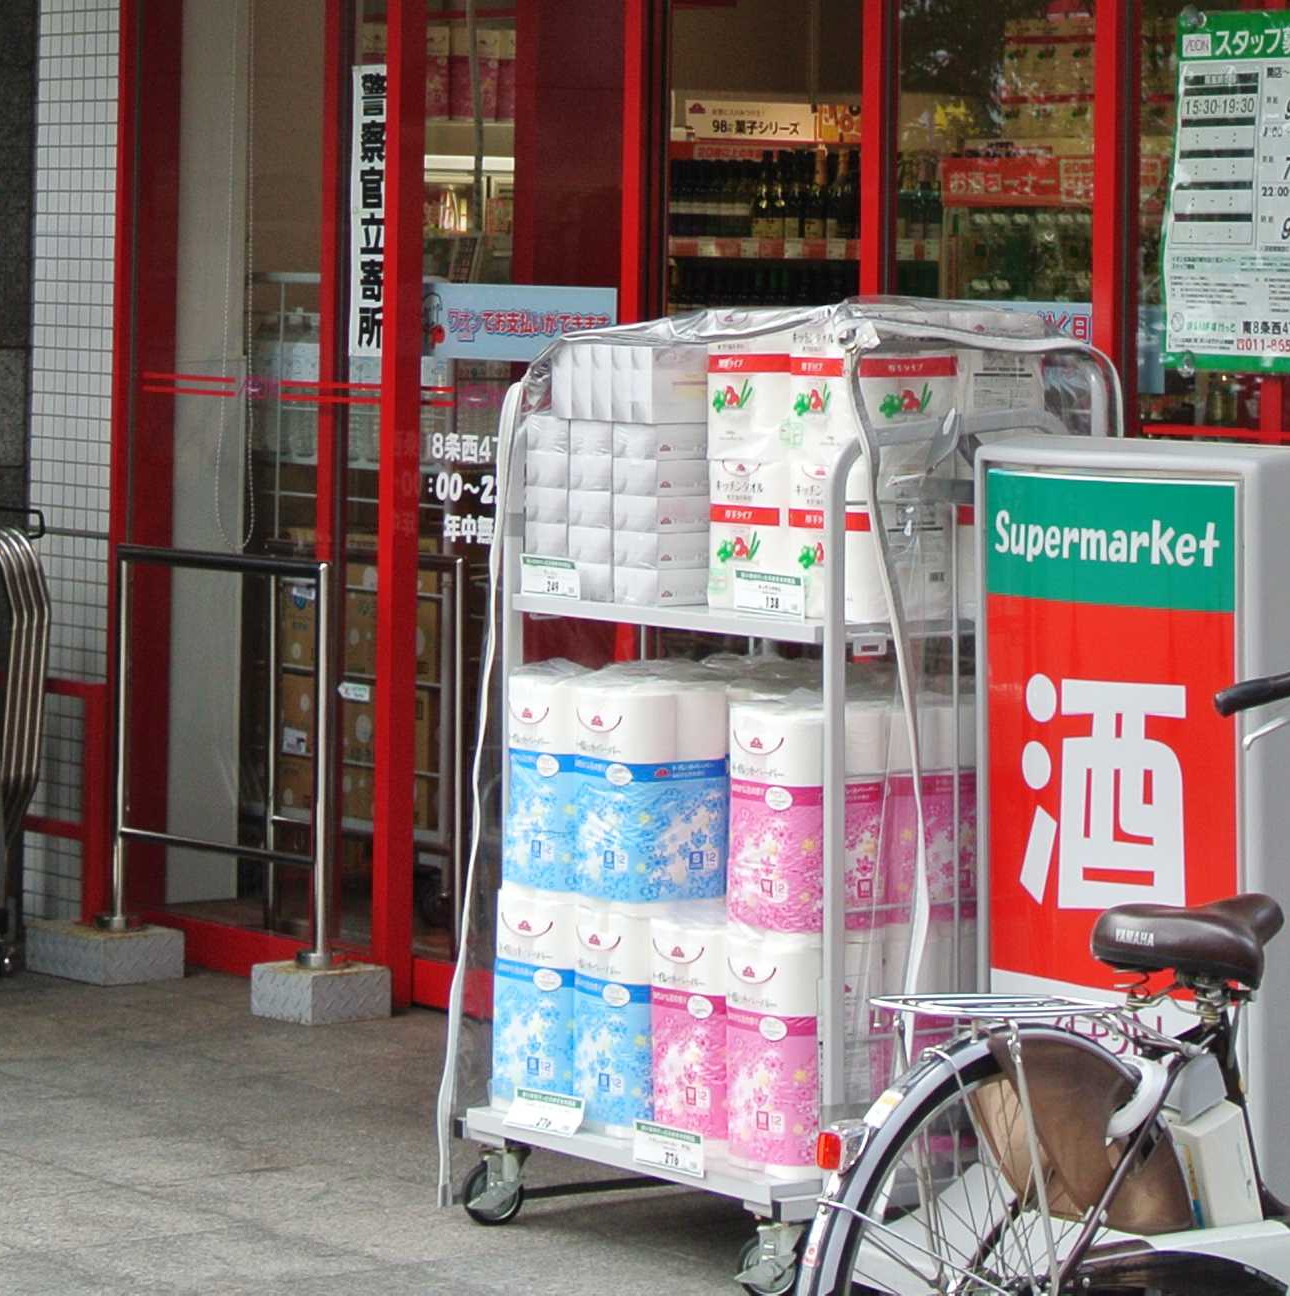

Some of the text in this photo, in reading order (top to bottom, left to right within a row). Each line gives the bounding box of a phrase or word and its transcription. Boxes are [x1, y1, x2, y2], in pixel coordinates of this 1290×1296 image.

[358, 73, 387, 349] 警察官立寄所
[994, 508, 1221, 568] Supermarket
[1018, 672, 1187, 910] 酒
[1115, 928, 1155, 947] YAMAHA
